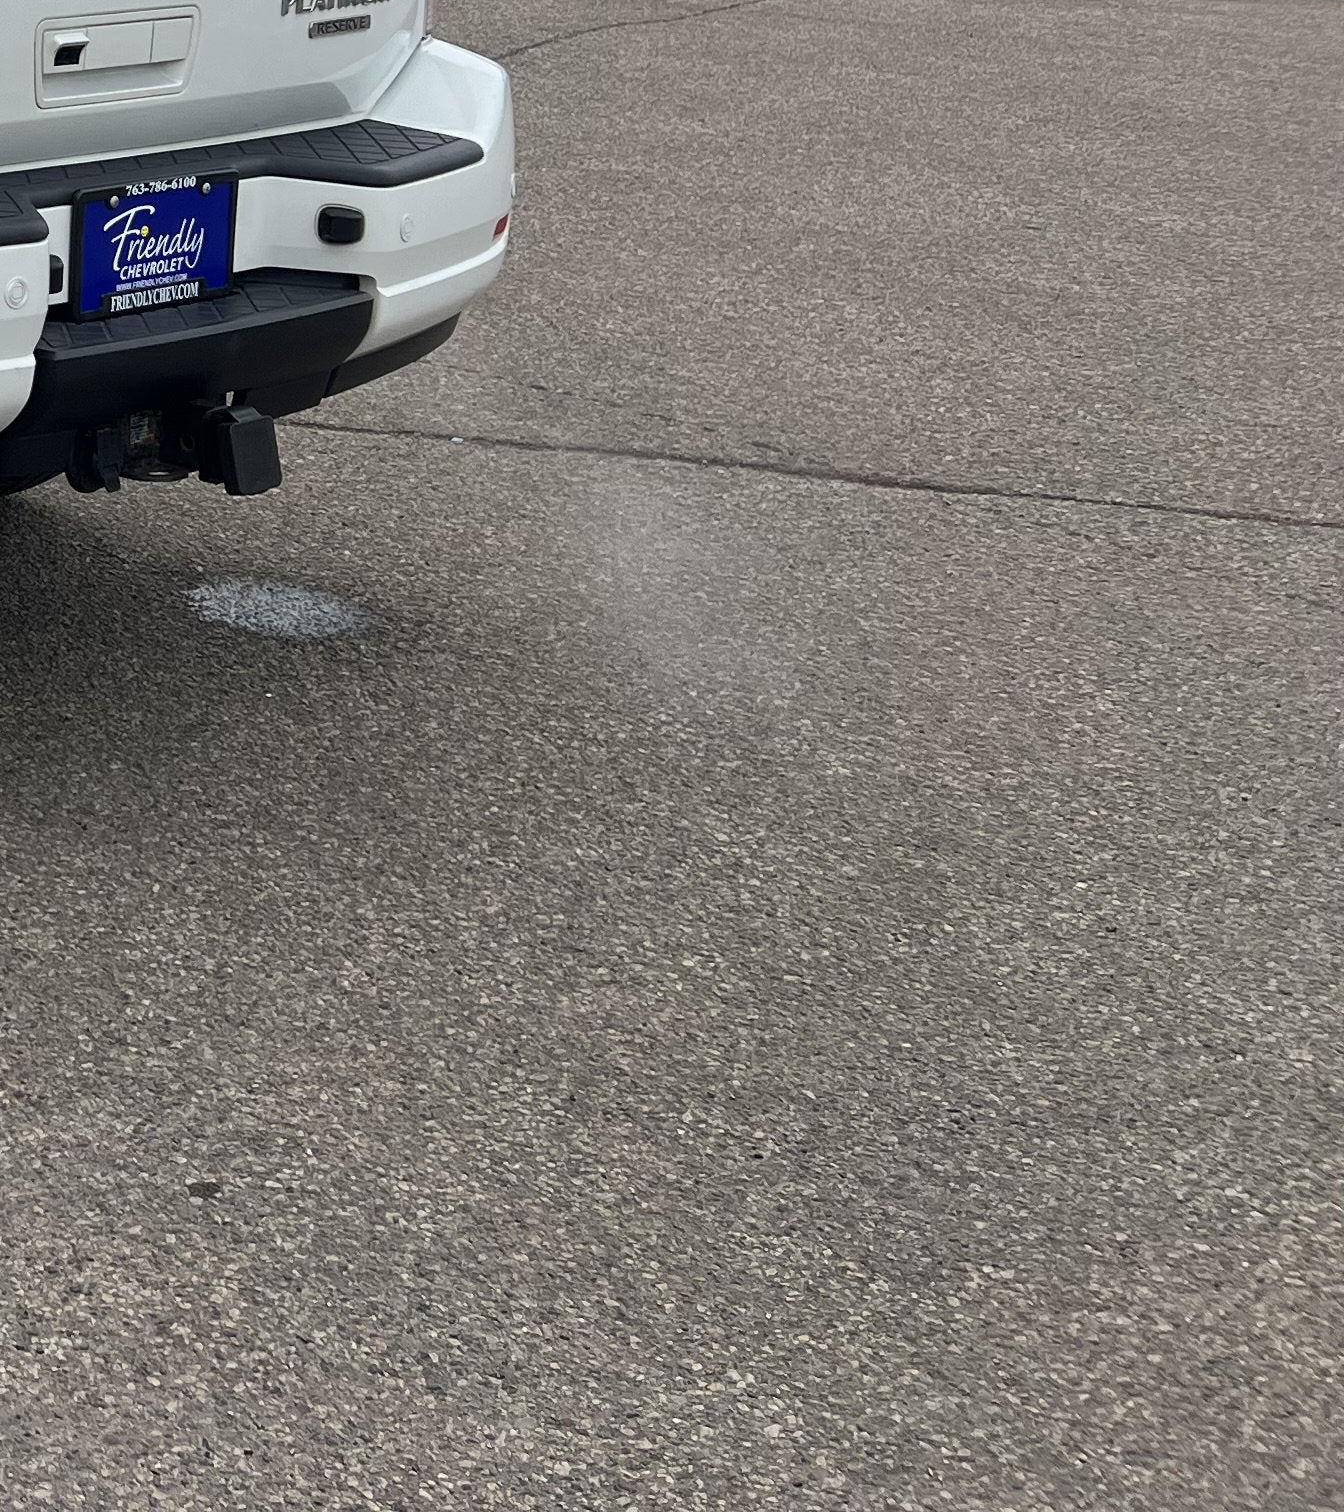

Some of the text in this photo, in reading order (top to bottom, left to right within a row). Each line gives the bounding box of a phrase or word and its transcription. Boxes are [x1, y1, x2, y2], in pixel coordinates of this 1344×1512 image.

[316, 17, 367, 35] RESERVE
[126, 175, 197, 197] 763-786-6100
[103, 205, 205, 272] Friendly
[119, 256, 186, 281] CHEVROLET
[110, 281, 200, 313] FRIENDLYCHEV.COM
